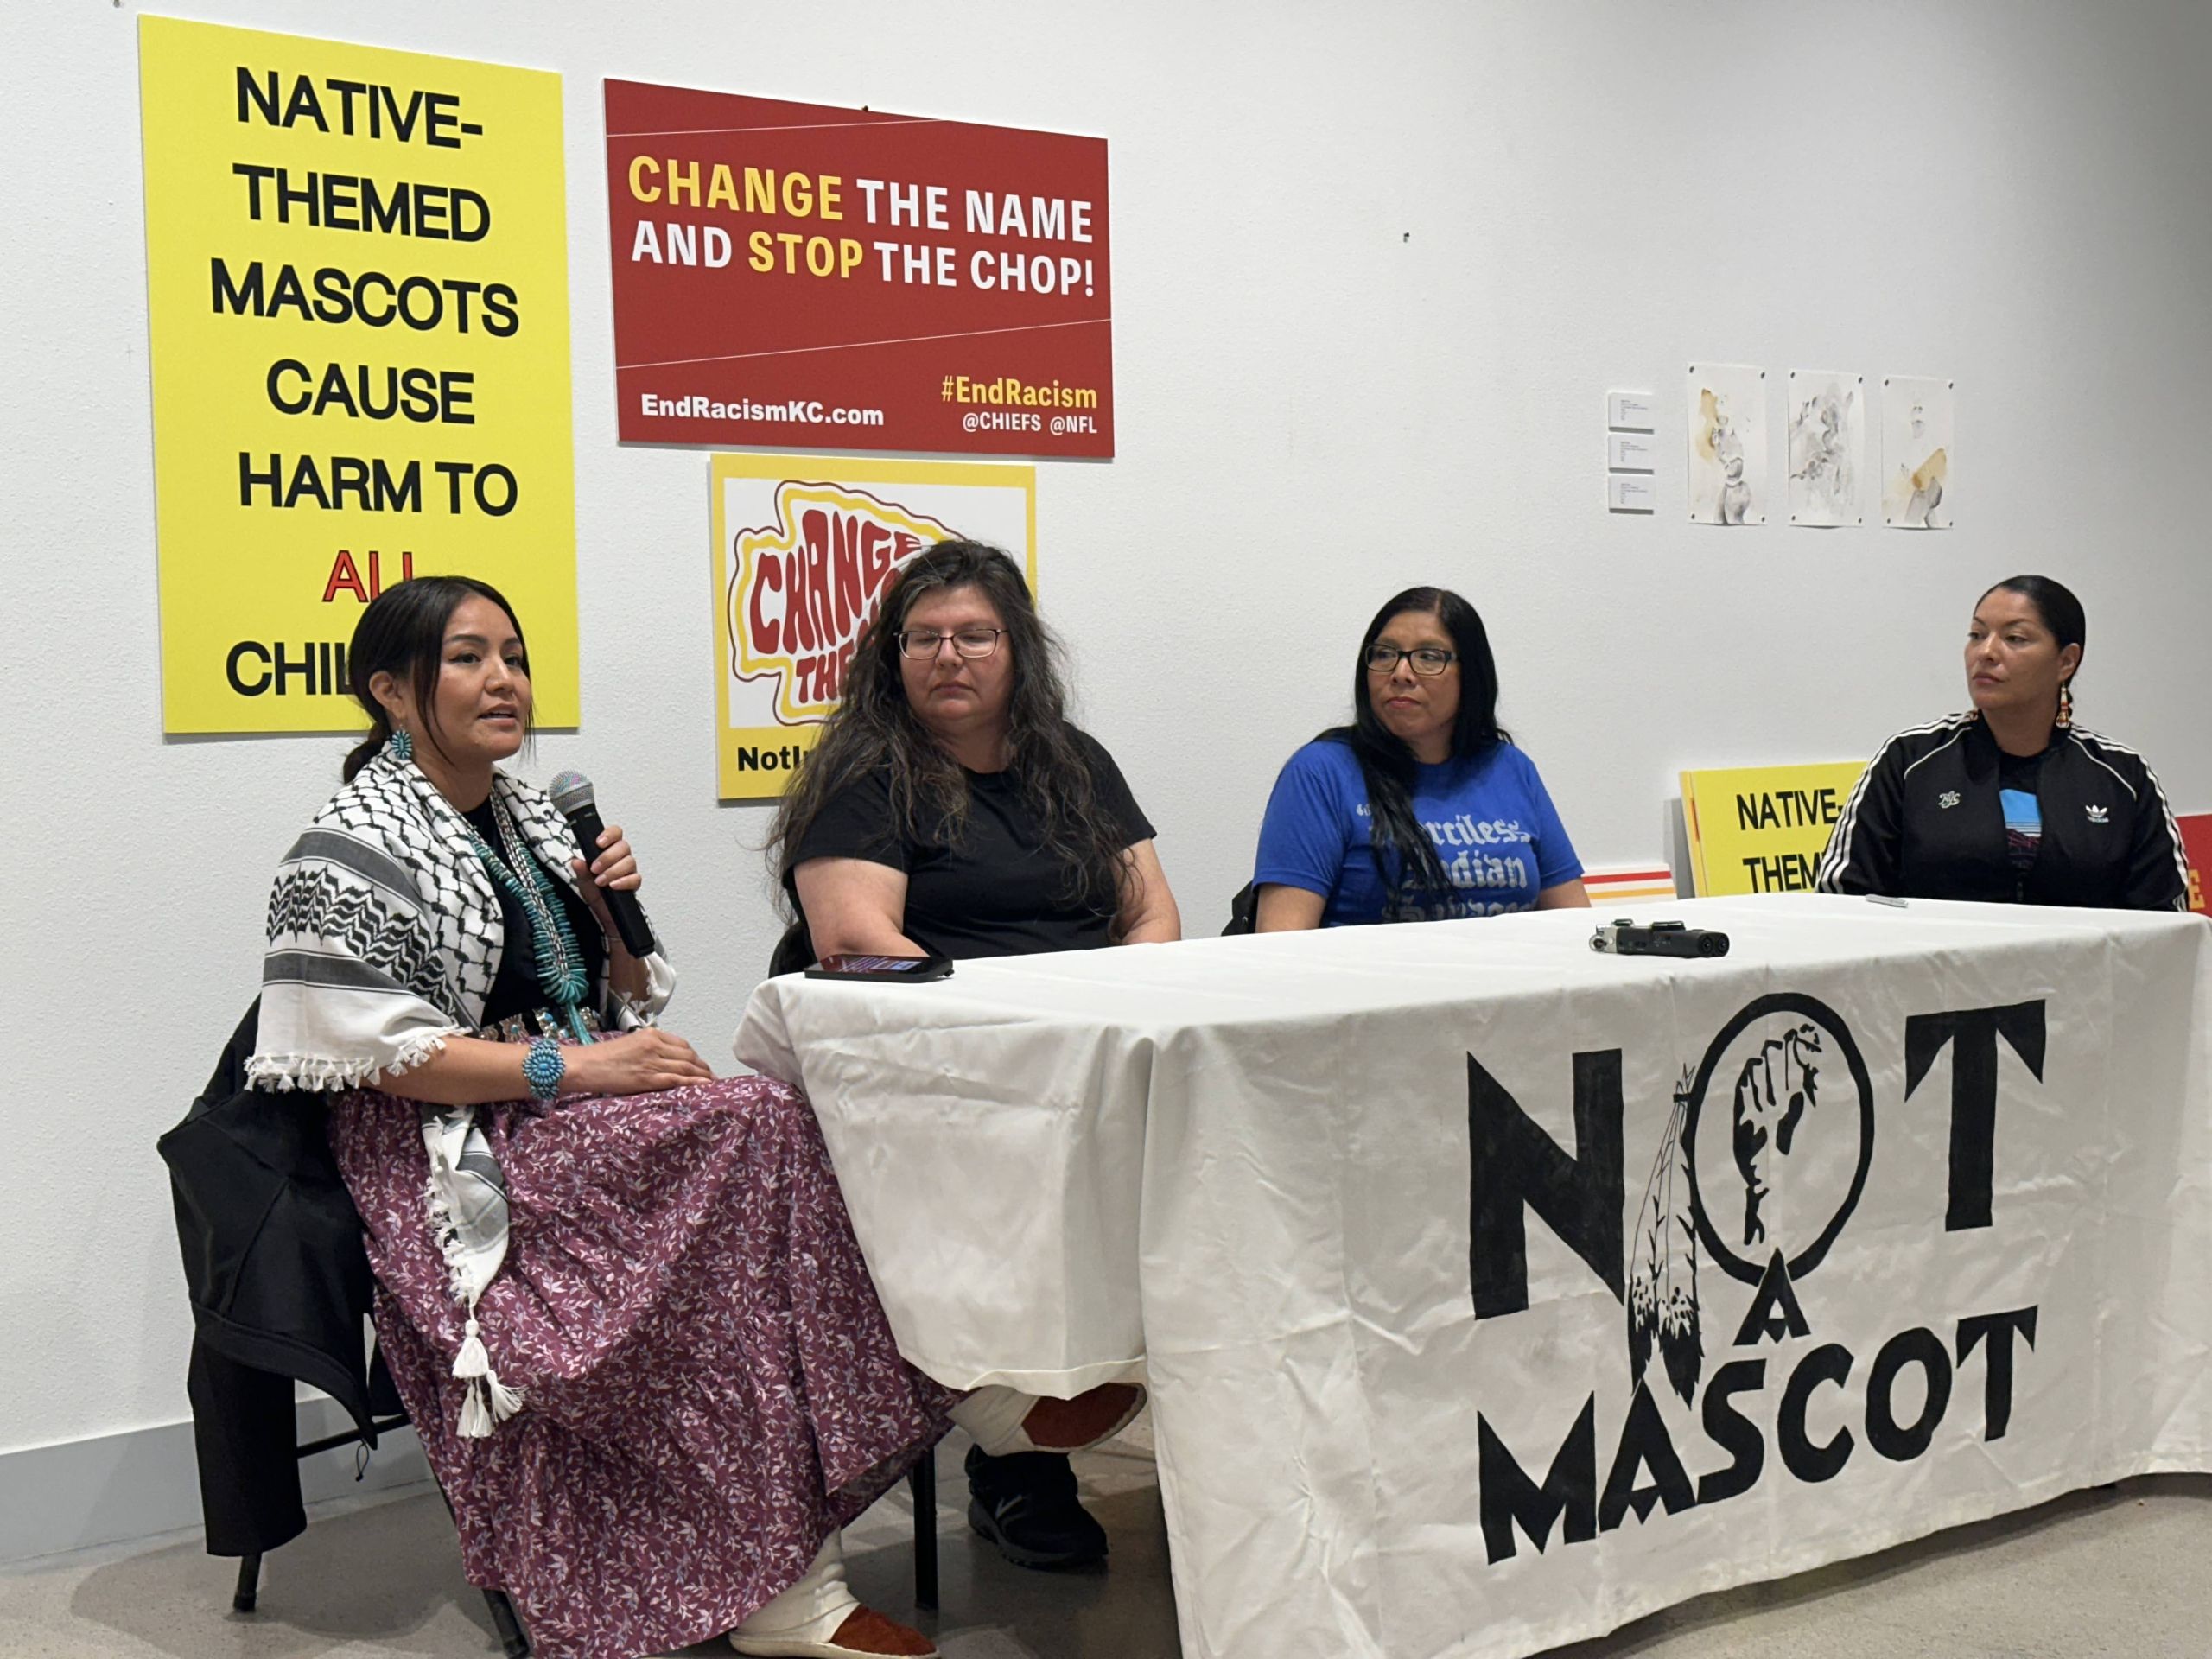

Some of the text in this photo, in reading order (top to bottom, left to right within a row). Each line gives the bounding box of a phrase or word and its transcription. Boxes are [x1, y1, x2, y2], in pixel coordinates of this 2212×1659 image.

[236, 66, 483, 149] NATIVE-
[232, 162, 491, 243] THEMED
[628, 155, 1093, 244] CHANGE THE NAME
[211, 257, 519, 338] MASCOTS
[632, 219, 1094, 297] AND STOP THE CHOP!
[266, 359, 475, 425] CAUSE
[641, 393, 885, 426] EndRacismKC.com
[941, 374, 1097, 409] #EndRacism
[963, 411, 1097, 435] @CHIEFS @NFL
[238, 451, 518, 517] HARM TO
[749, 509, 921, 655] CHANGE
[226, 640, 356, 697] CHIL
[1742, 852, 1825, 893] THEM
[1467, 991, 2046, 1320] NOT
[1732, 1248, 1812, 1346] A
[1476, 1305, 2039, 1566] MASCOT
